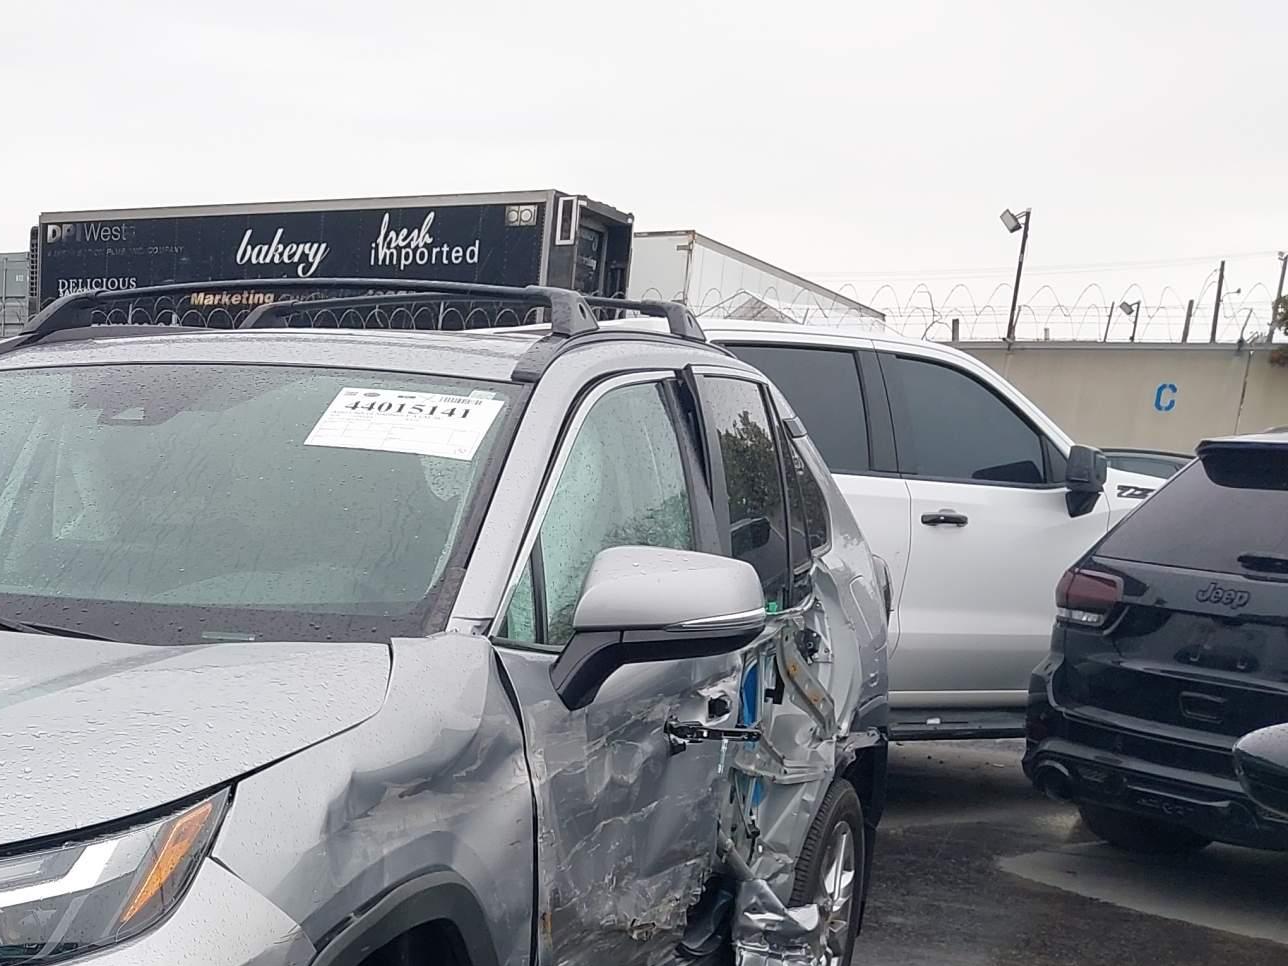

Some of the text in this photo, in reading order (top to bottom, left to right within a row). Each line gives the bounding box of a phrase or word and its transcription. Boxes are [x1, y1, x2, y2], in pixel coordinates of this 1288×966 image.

[84, 222, 127, 241] West
[376, 211, 435, 258] fresh
[236, 228, 329, 277] bakery
[370, 240, 480, 270] imported
[58, 277, 137, 291] DELICIOUS
[190, 290, 274, 305] Marketing
[344, 400, 472, 419] 44015141
[1154, 383, 1177, 412] C
[1196, 583, 1250, 608] Jeep
